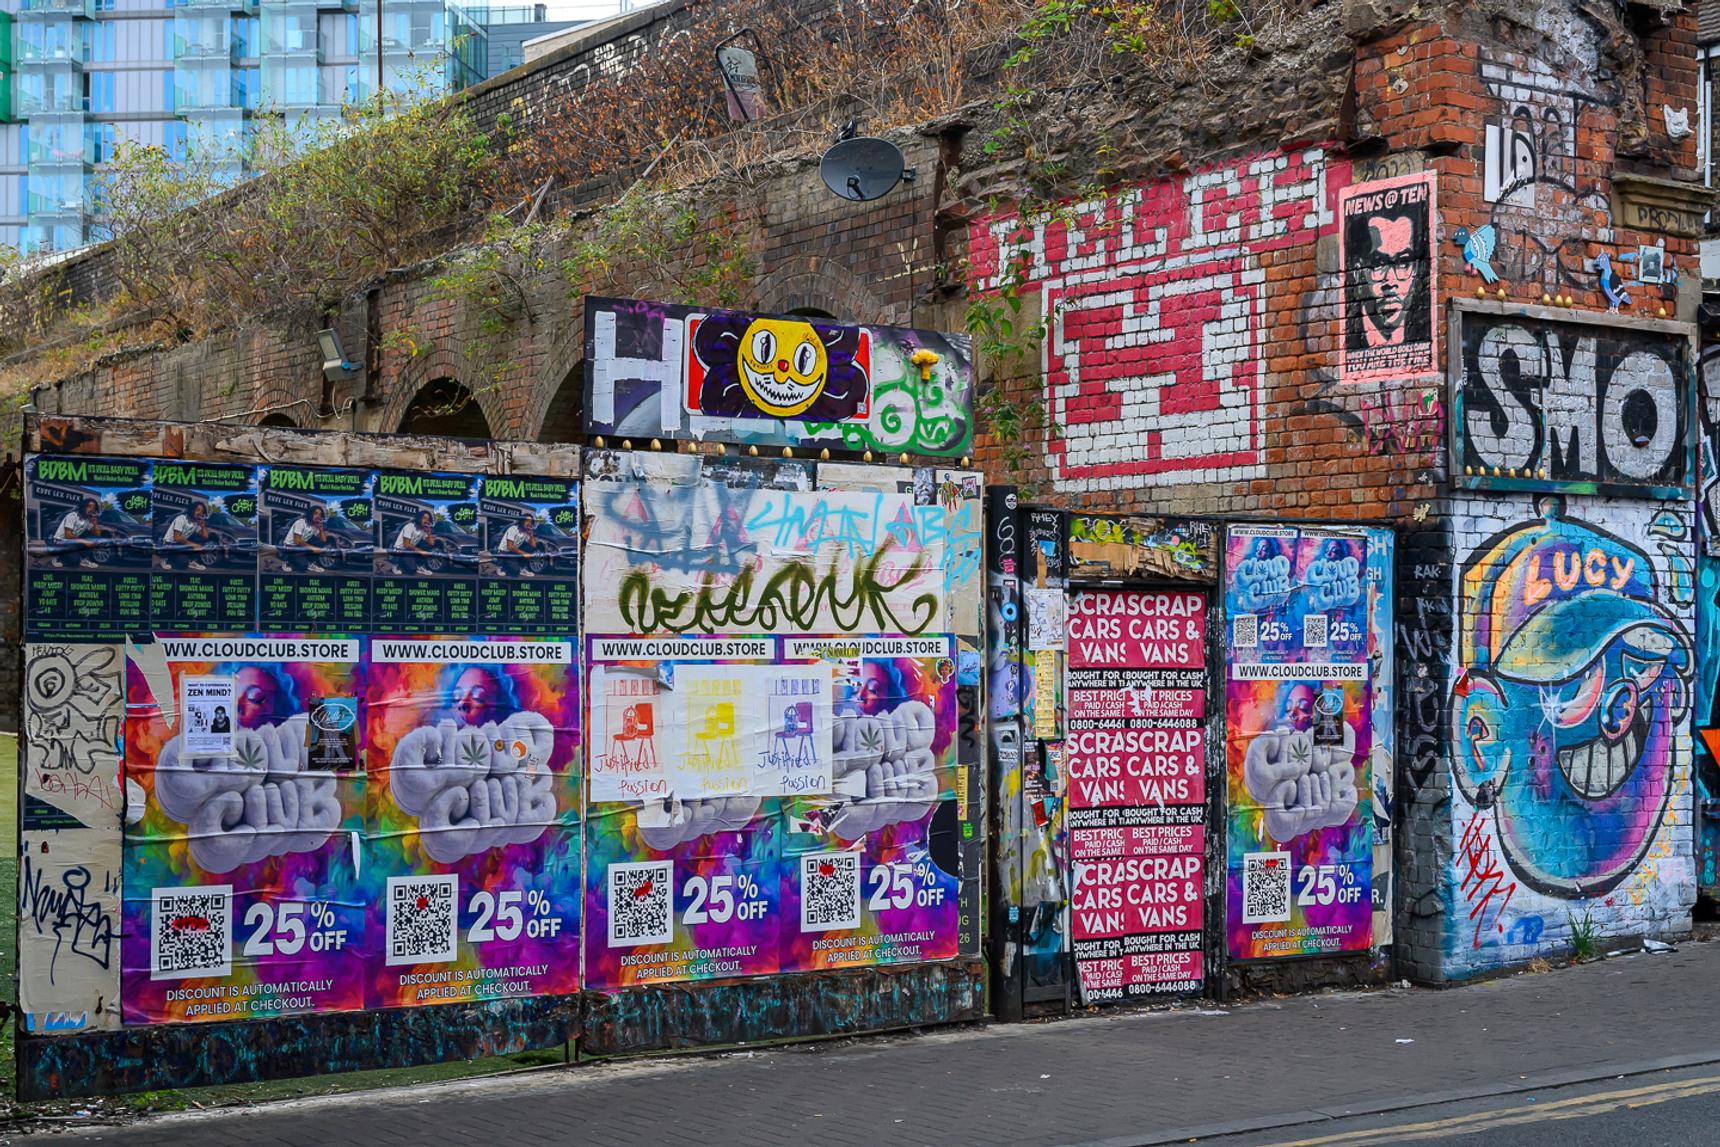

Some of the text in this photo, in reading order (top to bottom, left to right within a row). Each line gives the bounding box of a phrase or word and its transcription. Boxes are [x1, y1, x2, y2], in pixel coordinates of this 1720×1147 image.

[1345, 184, 1428, 216] NEWS @ TEN
[1376, 346, 1397, 356] WORLD
[39, 460, 87, 481] BDBM
[269, 469, 315, 490] BDBM
[380, 475, 423, 494] BDBM
[485, 479, 525, 498] BDBM
[1526, 548, 1635, 605] LUCY
[1126, 595, 1202, 617] SCRAP
[1069, 618, 1121, 639] CARS
[1128, 619, 1200, 640] CARS &
[1260, 622, 1280, 641] 25
[1280, 623, 1288, 631] %
[1280, 632, 1292, 641] OFF
[1330, 622, 1350, 642] 25
[1350, 633, 1362, 642] OFF
[162, 642, 349, 658] WW.CLOUDCLUB.STORE
[383, 644, 562, 660] WWW.CLOUDCLUB.STORE
[602, 642, 766, 656] WWW.CLOUDCLUB.STORE
[1139, 642, 1189, 664] VANS
[1127, 671, 1203, 680] BOUGHT FOR CASH
[1239, 666, 1362, 678] WWW.CLOUDCLUB.STORE
[187, 688, 232, 697] ZEN MIND?
[1126, 680, 1165, 688] ANYWHERE
[1176, 680, 1189, 688] THE
[1159, 690, 1193, 700] PRICES
[1165, 701, 1183, 709] CASH
[1160, 709, 1193, 717] SAME DAY
[1130, 719, 1198, 729] 0800-6446088
[1126, 731, 1201, 753] SCRAP
[1069, 756, 1121, 779] CARS
[1127, 755, 1200, 776] CARS &
[1139, 779, 1189, 801] VANS
[1132, 826, 1192, 838] BEST PRICES
[1143, 837, 1182, 846] PAID CASH
[917, 862, 936, 887] %
[1126, 857, 1201, 880] SCRAP
[1338, 864, 1354, 886] %
[737, 873, 758, 898] %
[868, 862, 914, 912] 25
[1127, 881, 1198, 905] CARS &
[1297, 865, 1336, 907] 25
[1338, 887, 1362, 904] OFF
[527, 889, 550, 917] %
[681, 874, 734, 926] 25
[917, 887, 944, 908] OFF
[1072, 887, 1122, 910] CARS
[310, 901, 335, 929] %
[467, 891, 523, 943] 25
[737, 900, 768, 922] OFF
[1138, 906, 1188, 928] VANS
[243, 902, 306, 957] 25
[526, 918, 562, 939] OFF
[1252, 924, 1353, 940] DISCOUNT IS AUTOMATICALLY
[310, 929, 348, 952] OFF
[813, 931, 935, 950] DISCOUNT IS AUTOMATICALLY
[1124, 933, 1200, 946] BOUGHT FOR CASH
[1124, 944, 1163, 954] ANYWHERE
[1263, 938, 1341, 951] APPLIED AT CHECKOUT.
[621, 945, 757, 967] DISCOUNT IS AUTOMATICALLY
[827, 945, 922, 963] APPLIED AT CHECKOUT.
[1131, 953, 1190, 967] BEST PRICES
[400, 964, 549, 985] DISCOUNT IS AUTOMATICALLY
[636, 960, 742, 979] APPLIED AT CHECKOUT.
[166, 979, 333, 1001] DISCOUNT IS AUTOMATICALLY
[416, 980, 532, 999] APPLIED AT CHECKOUT.
[1128, 981, 1196, 994] 0800-6446088
[185, 996, 315, 1016] APPLIED AT CHECKOUT.
